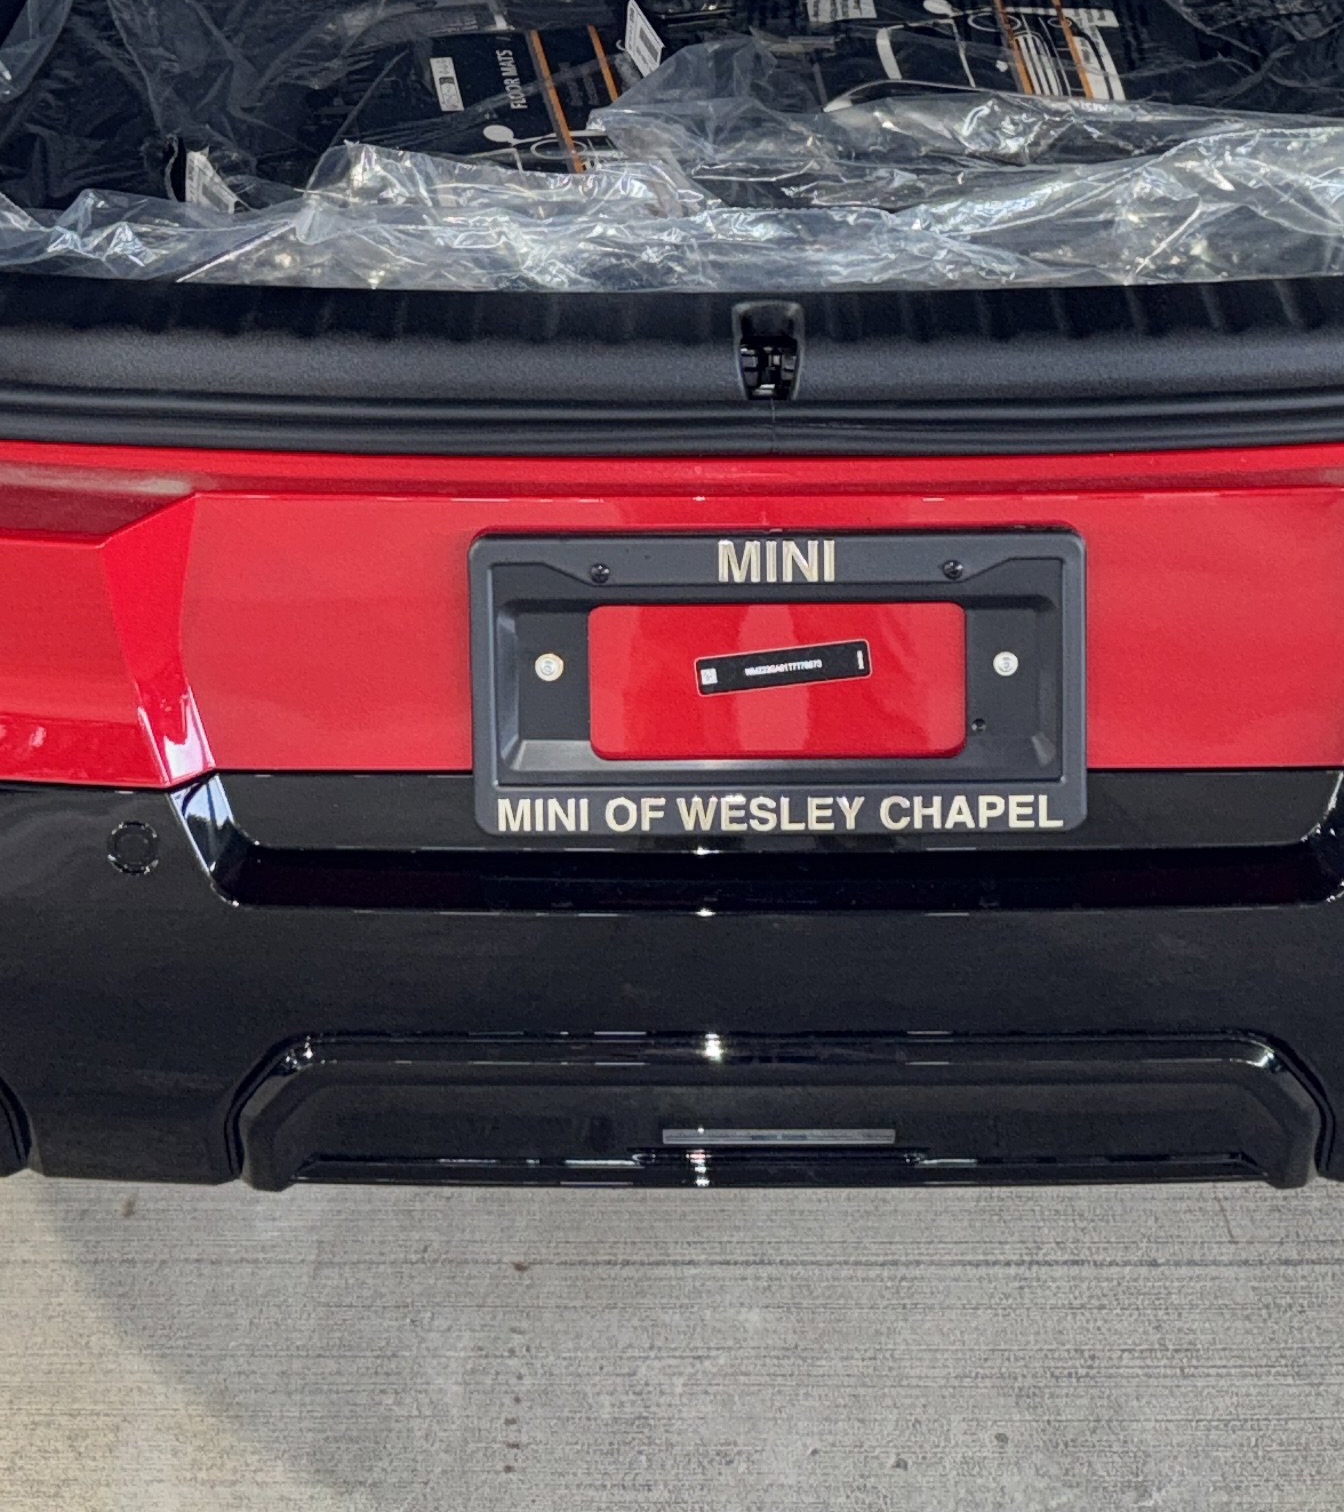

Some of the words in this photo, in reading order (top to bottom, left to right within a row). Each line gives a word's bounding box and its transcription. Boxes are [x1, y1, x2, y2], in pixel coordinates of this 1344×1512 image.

[495, 49, 519, 77] MATS
[503, 78, 528, 109] FLOOR
[717, 539, 835, 583] MINI
[497, 798, 589, 832] MINI
[604, 797, 666, 832] OF
[676, 796, 865, 832] WESLEY
[879, 794, 1064, 831] CHAPEL
